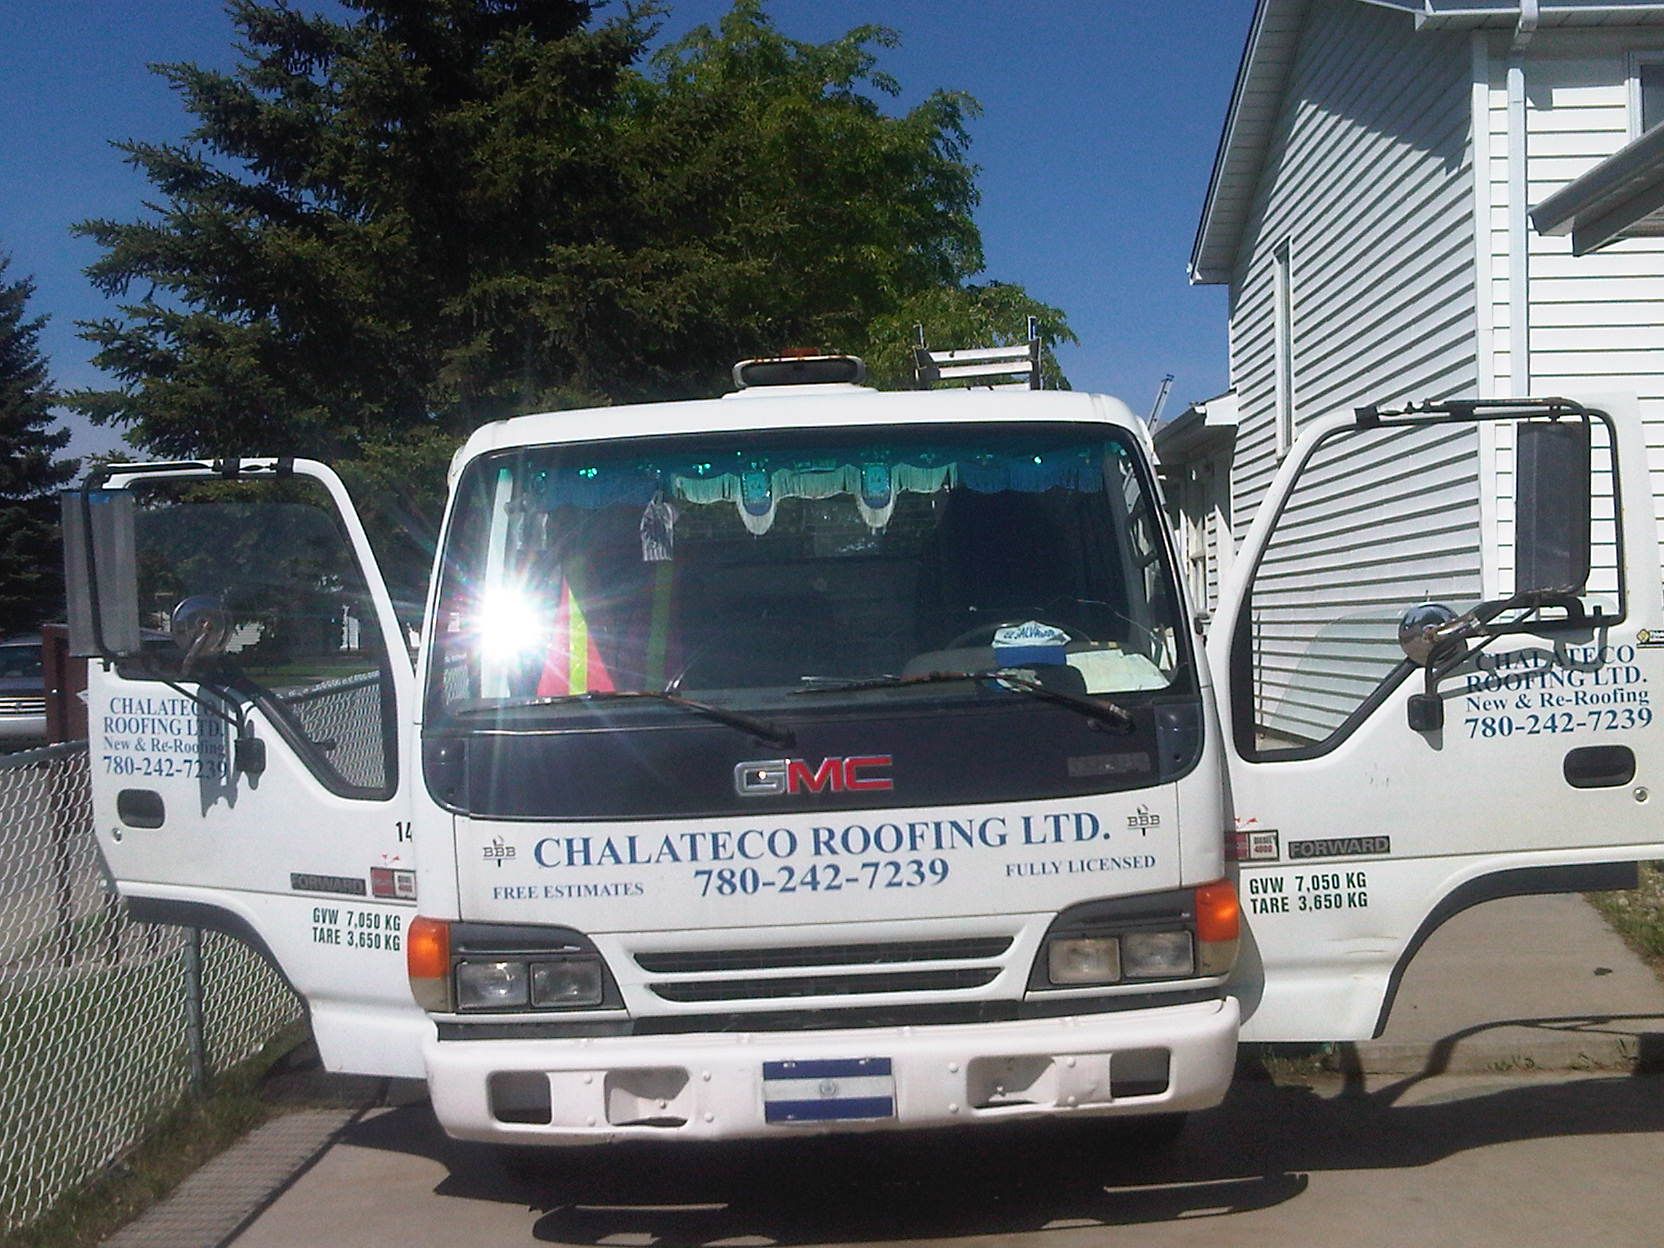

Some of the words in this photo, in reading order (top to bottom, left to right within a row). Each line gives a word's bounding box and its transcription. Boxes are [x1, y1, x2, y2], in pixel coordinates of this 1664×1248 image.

[1476, 645, 1635, 671] CHALATECO
[1466, 670, 1585, 693] ROOFING
[1594, 667, 1648, 687] LTD.
[1467, 695, 1507, 712] New
[1515, 694, 1531, 710] &
[1540, 689, 1650, 708] Re-Roofing
[104, 716, 181, 735] ROOFING
[187, 718, 224, 737] LTD.
[1464, 707, 1653, 739] 780-242-7239
[104, 736, 129, 751] New
[135, 738, 145, 751] &
[151, 738, 225, 756] Re-Roofing
[103, 755, 227, 780] 780-242-7239
[734, 755, 893, 796] GMC
[1127, 815, 1160, 827] BBB
[484, 846, 516, 857] BBB
[533, 828, 798, 868] CHALATECO
[811, 815, 1007, 857] ROOFING
[1021, 812, 1110, 845] LTD.
[1290, 837, 1389, 857] FORWARD
[694, 858, 949, 897] 780-242-7239
[1006, 862, 1063, 877] FULLY
[1069, 855, 1156, 873] LICENSED
[493, 886, 538, 900] FREE
[544, 882, 645, 898] ESTIMATES
[1250, 877, 1284, 895] GVW
[1295, 873, 1340, 892] 7,050
[1346, 871, 1367, 889] KG
[1250, 896, 1290, 915] TARE
[1298, 893, 1342, 912] 3,650
[1348, 891, 1368, 908] KG
[313, 907, 339, 925] GVW
[347, 911, 380, 929] 7,050
[385, 915, 401, 931] KG
[312, 927, 341, 945] TARE
[347, 931, 381, 949] 3,650
[385, 935, 401, 951] KG
